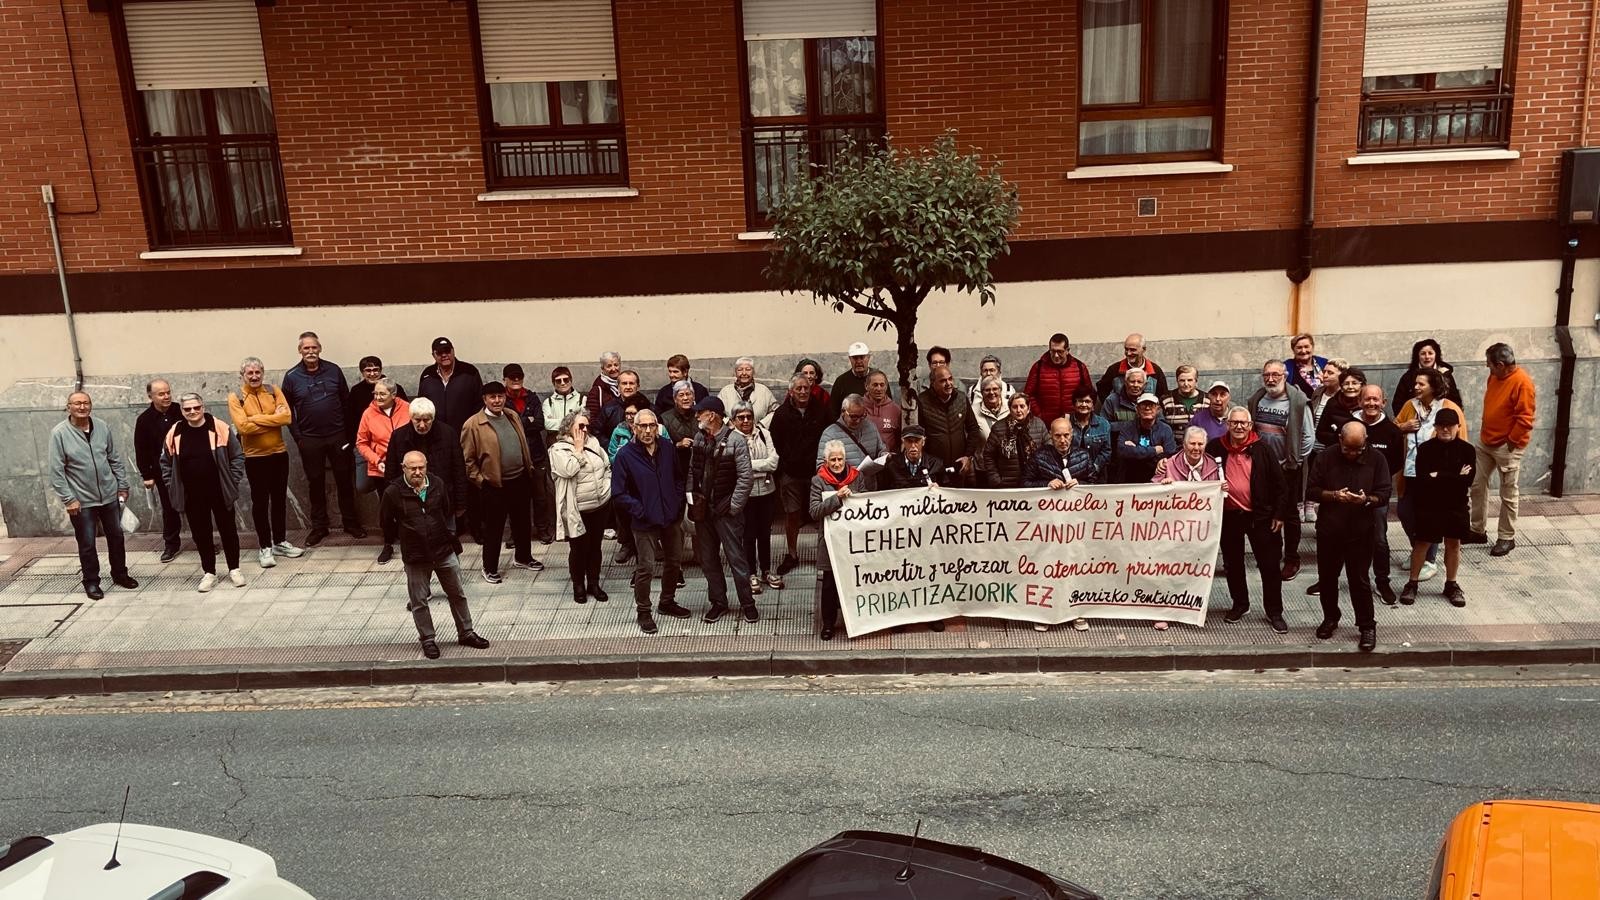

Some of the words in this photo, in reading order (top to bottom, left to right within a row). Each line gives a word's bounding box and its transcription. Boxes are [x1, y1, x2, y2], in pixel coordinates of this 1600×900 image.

[900, 495, 977, 517] militares
[986, 497, 1032, 517] para
[1038, 492, 1108, 512] escuelas
[1115, 500, 1124, 517] y
[1131, 492, 1212, 517] hospitales
[849, 527, 922, 554] LEHEN
[930, 522, 1009, 545] ARRETA
[1015, 521, 1086, 544] ZAINDU
[1092, 521, 1125, 541] ETA
[1130, 520, 1210, 542] INDARTU
[854, 558, 925, 587] Invertir
[929, 564, 937, 581] y
[940, 558, 1013, 581] reforzar
[1018, 555, 1039, 575] la
[1043, 556, 1119, 579] atención
[1126, 557, 1211, 584] primaria
[856, 582, 1019, 616] PRIBATIZAZIORIK
[1026, 584, 1054, 608] EZ
